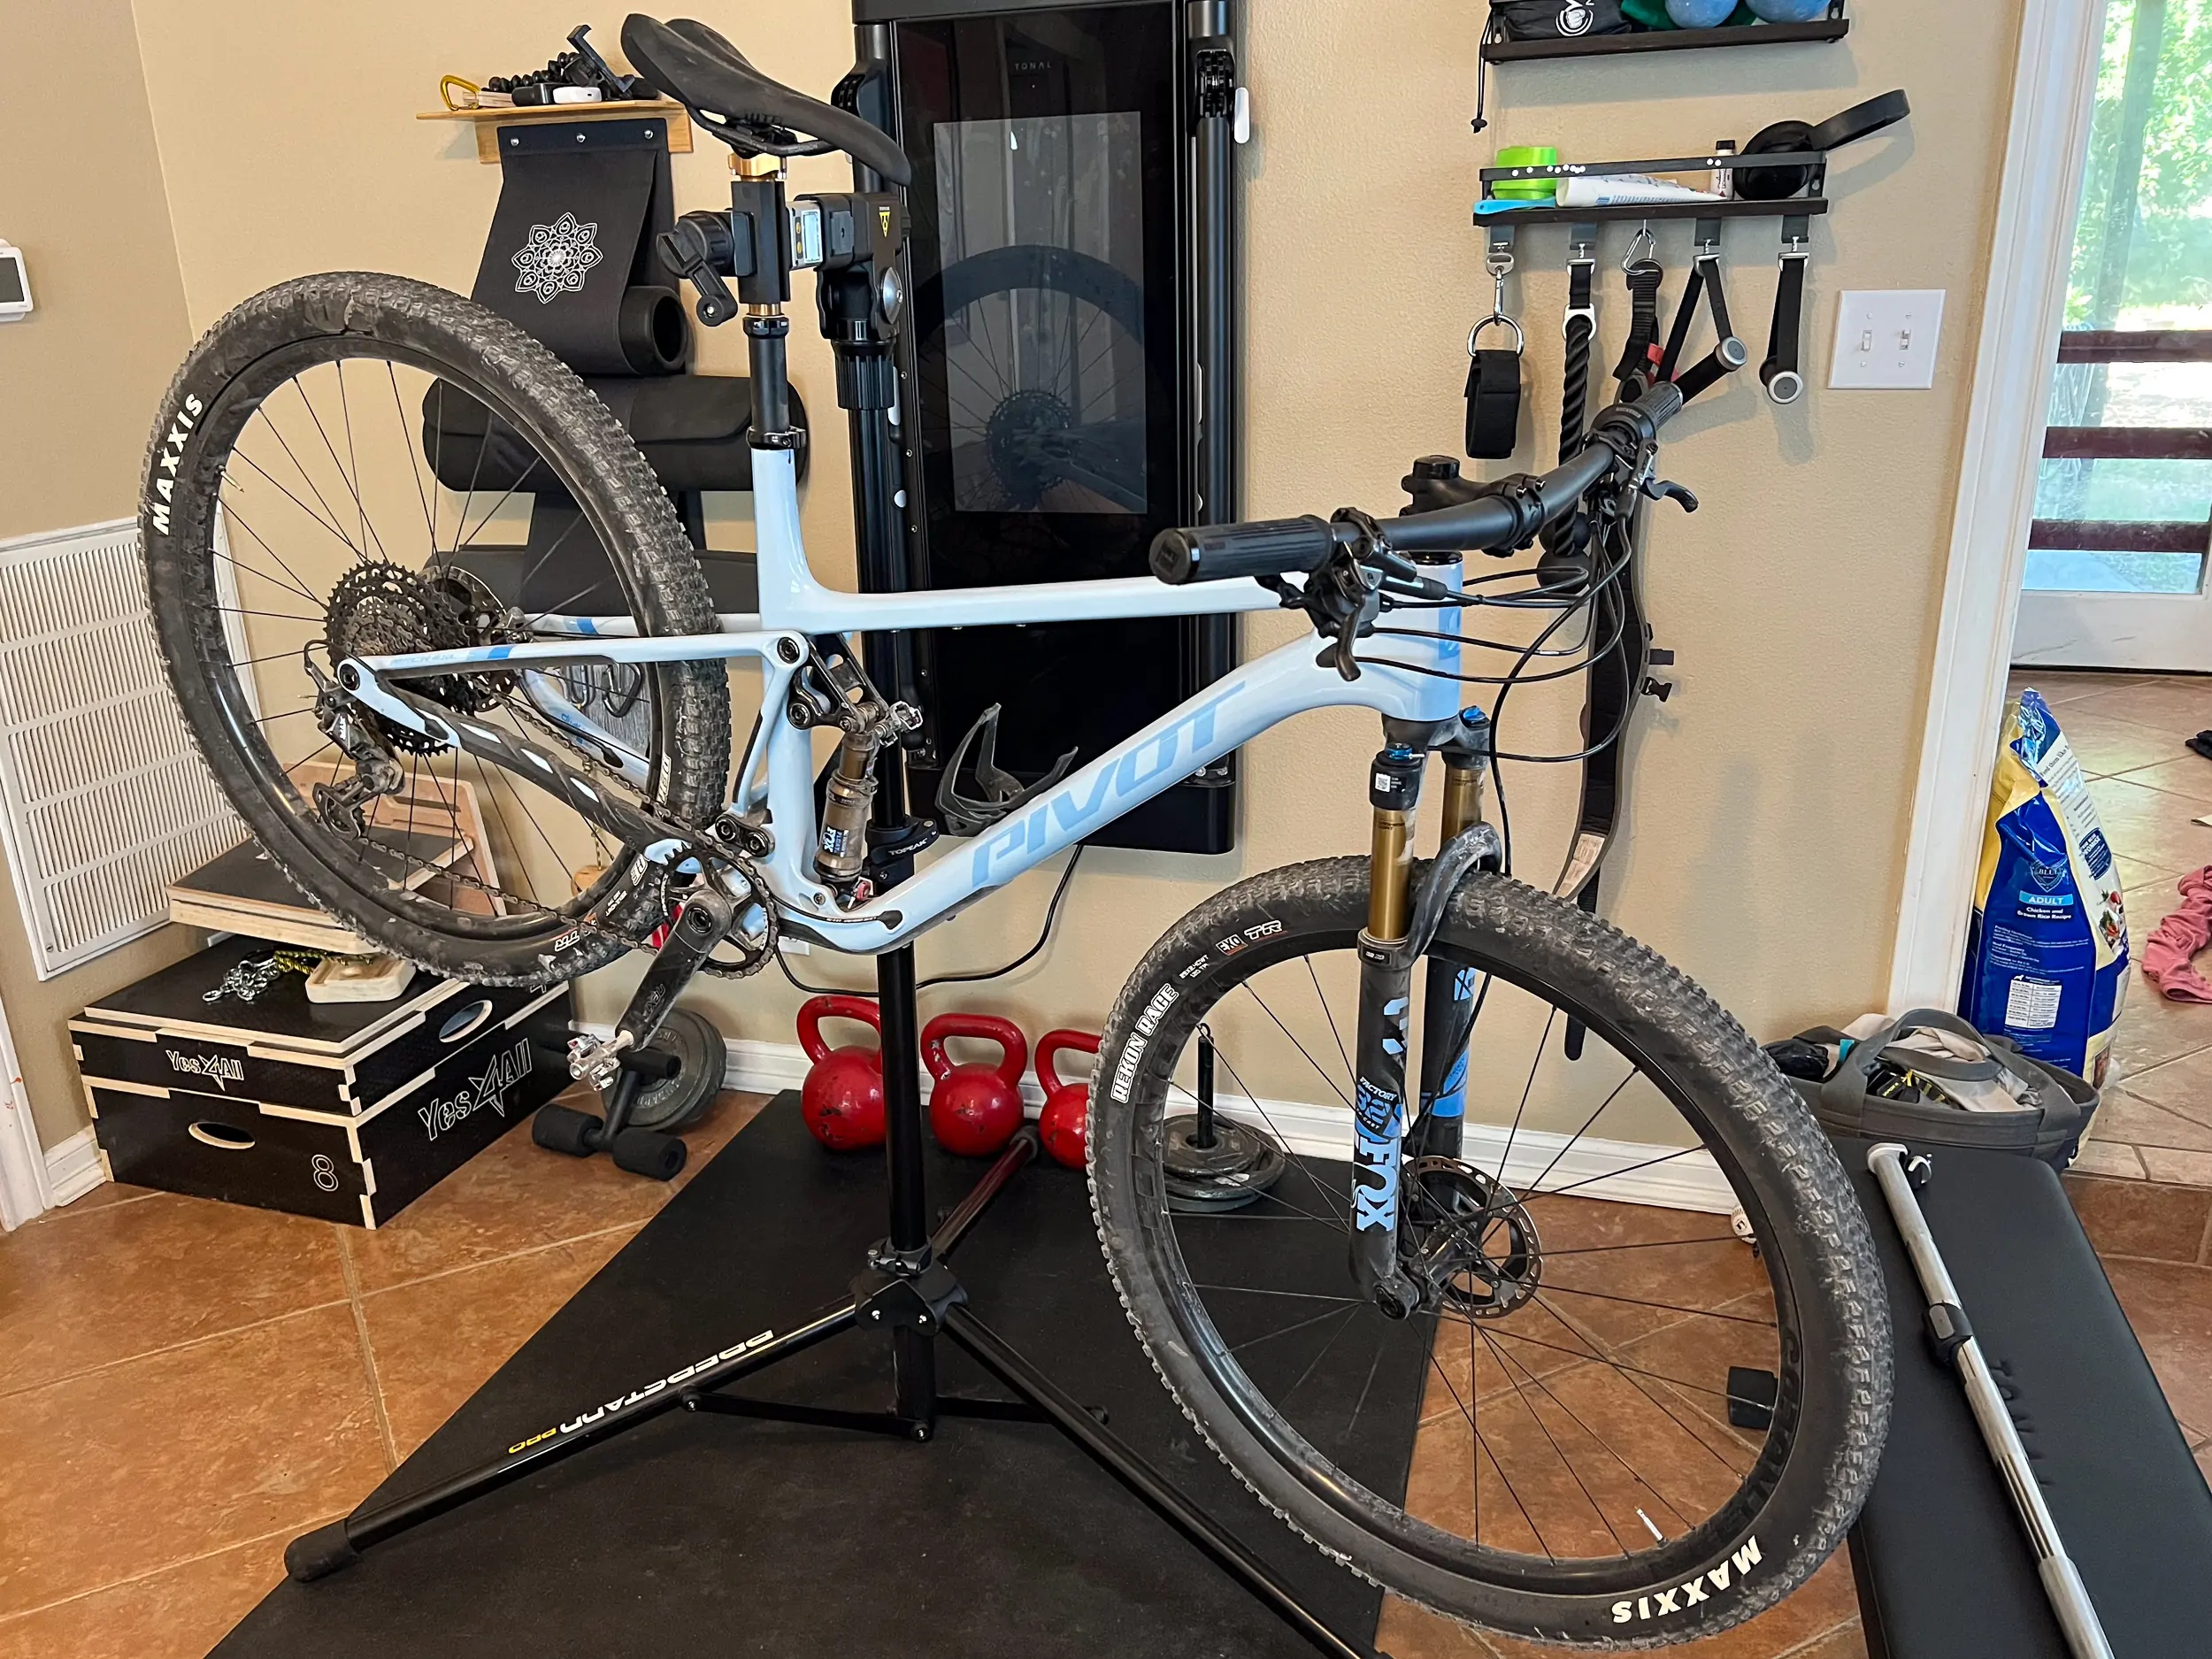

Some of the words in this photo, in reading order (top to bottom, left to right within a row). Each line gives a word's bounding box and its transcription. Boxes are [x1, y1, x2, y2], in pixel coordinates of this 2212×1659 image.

[1014, 61, 1052, 71] TONAL
[152, 393, 204, 536] MAXXIS
[972, 680, 1246, 890] PIVOT
[888, 837, 928, 856] TOPEAK
[2017, 910, 2037, 918] Brown
[2028, 896, 2064, 905] ADULT
[554, 930, 580, 952] TR
[1243, 920, 1283, 941] TR
[1110, 1032, 1148, 1104] REKON
[1134, 982, 1179, 1037] RACE
[165, 1049, 245, 1092] Yes4All
[417, 1037, 533, 1142] Yes4All
[1359, 1076, 1398, 1102] FACTORY
[1356, 1085, 1391, 1125] 32
[311, 1154, 339, 1192] 8
[1351, 1135, 1401, 1232] FOX
[1611, 1534, 1763, 1624] MAXXIS
